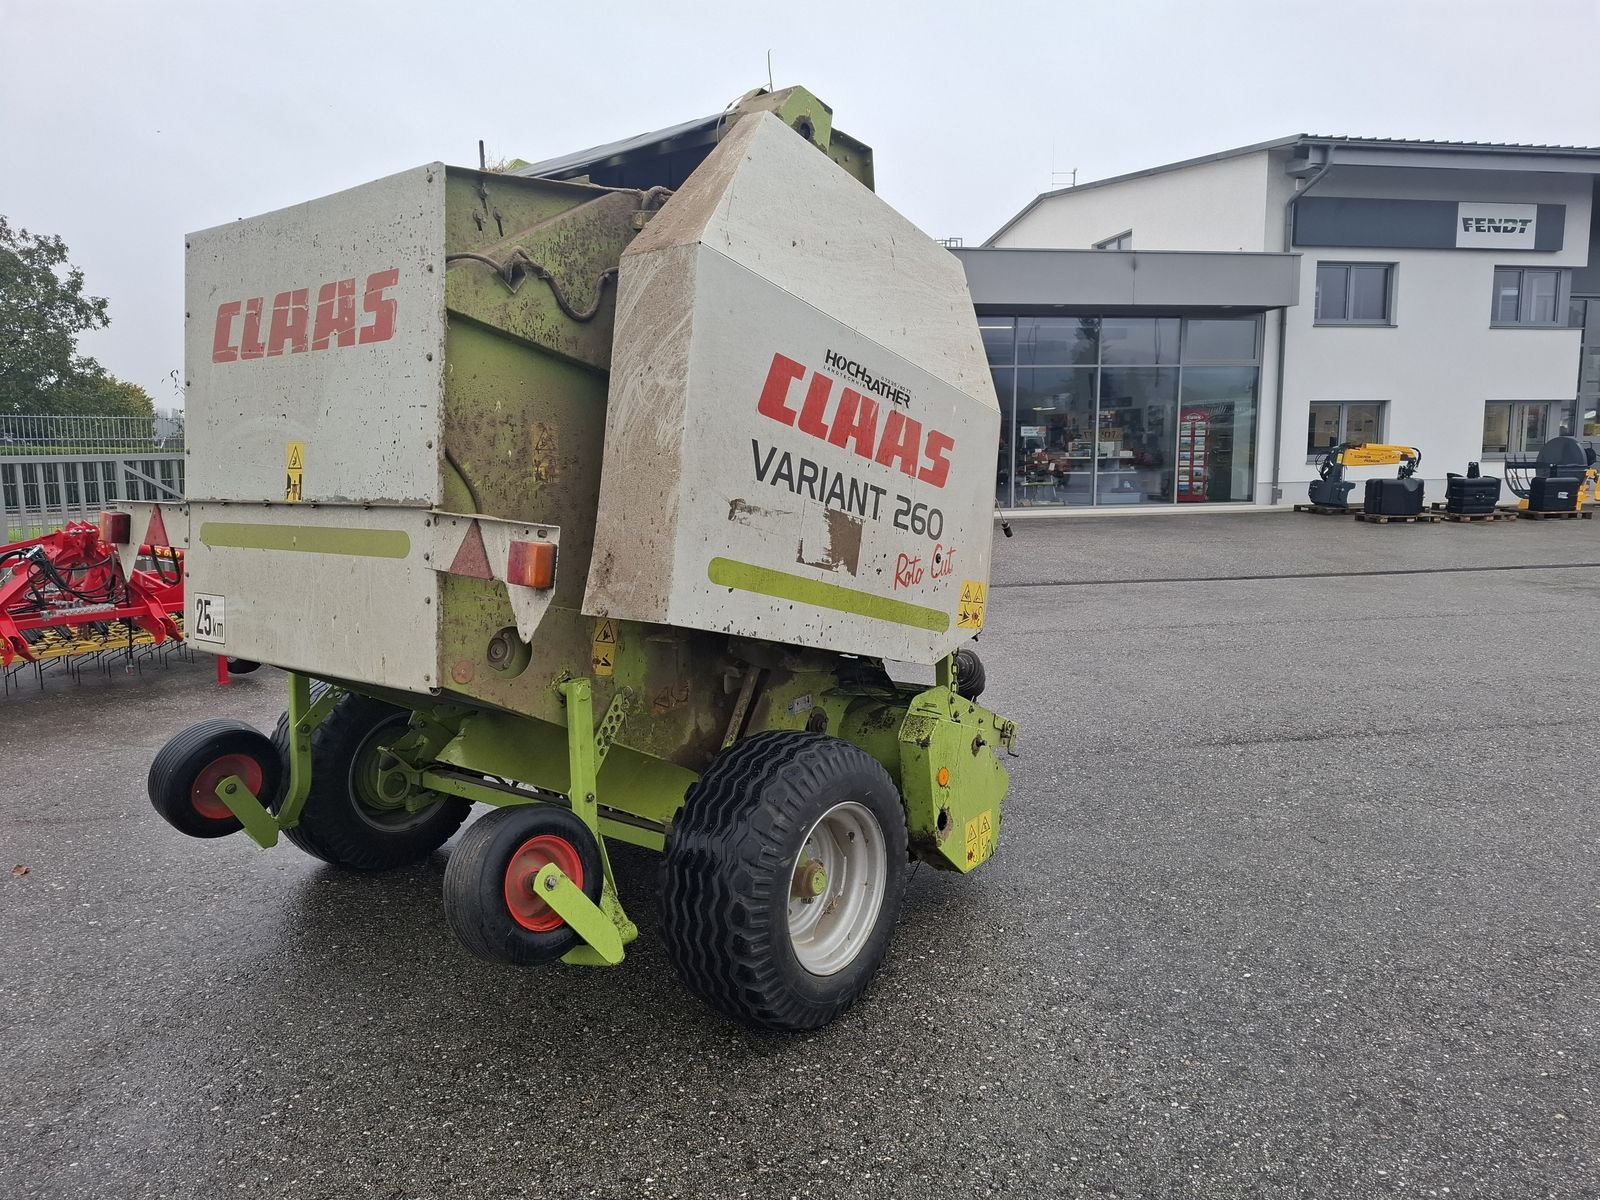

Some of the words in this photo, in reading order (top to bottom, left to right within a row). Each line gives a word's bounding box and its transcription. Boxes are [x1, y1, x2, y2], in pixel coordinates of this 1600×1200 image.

[1462, 217, 1533, 234] FENDT
[212, 267, 400, 364] CLAAS
[823, 364, 867, 389] LANDTECHNIK
[757, 352, 956, 489] CLAAS
[751, 438, 887, 521] VARIANT
[892, 494, 944, 541] 260
[893, 553, 925, 590] Roto
[930, 543, 956, 579] Cut
[196, 598, 212, 636] 25
[212, 617, 224, 638] km
